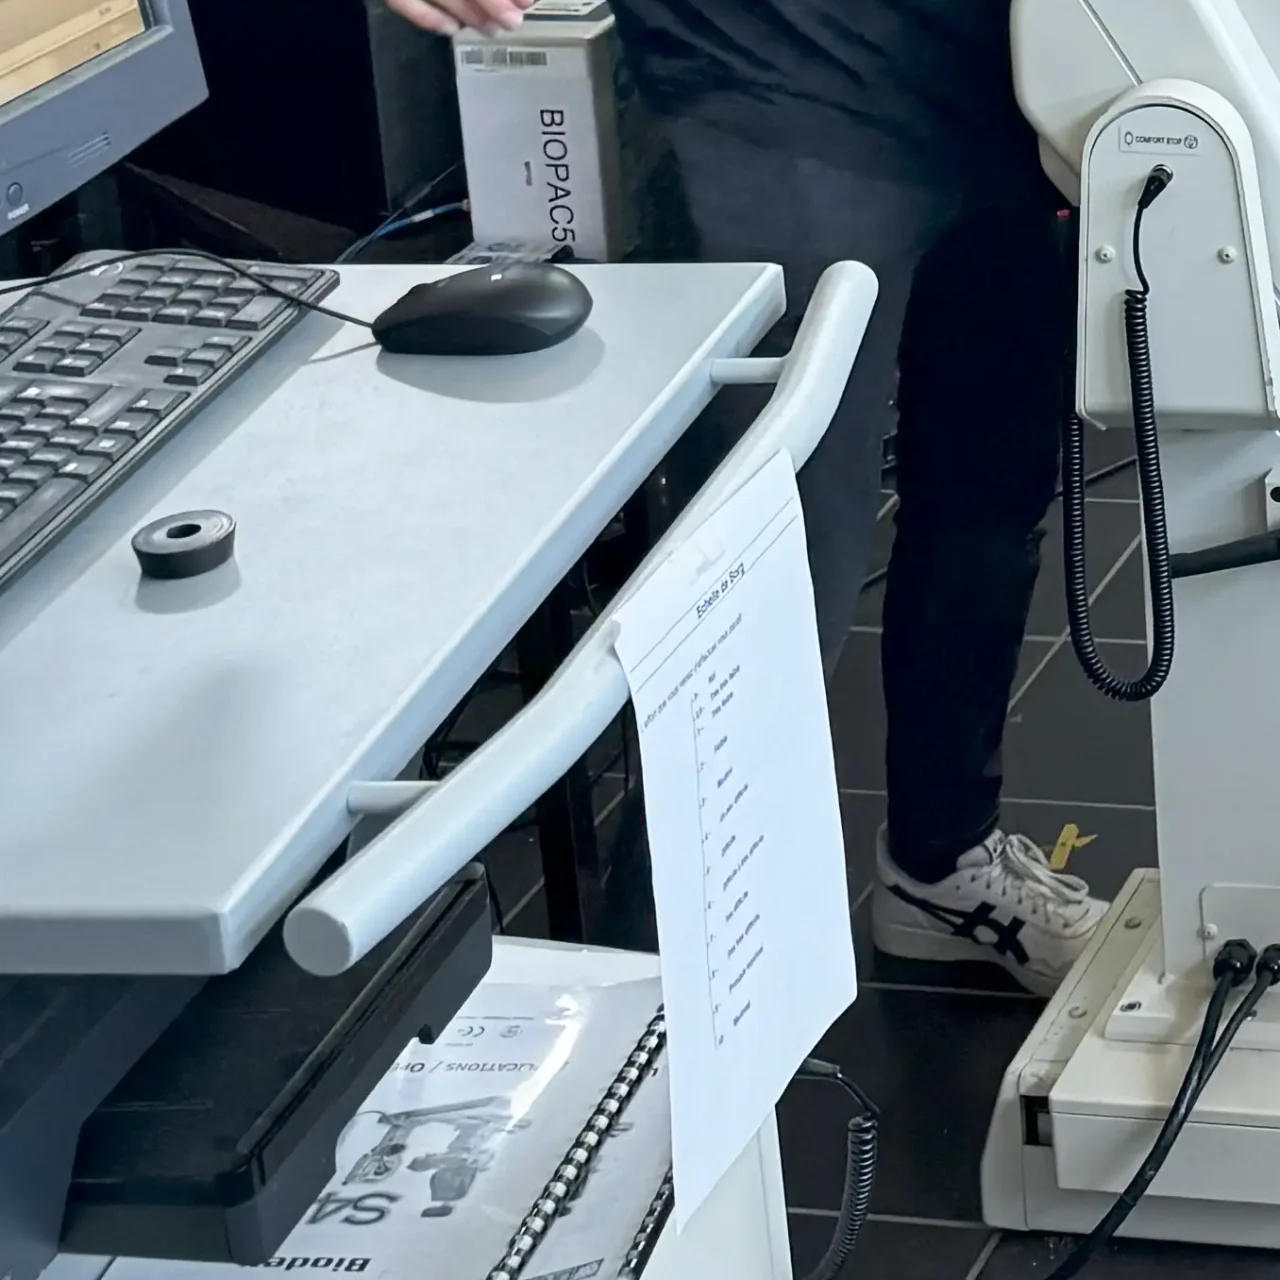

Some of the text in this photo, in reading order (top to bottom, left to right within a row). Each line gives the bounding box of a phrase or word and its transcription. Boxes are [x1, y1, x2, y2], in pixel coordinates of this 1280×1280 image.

[729, 562, 745, 584] Borg
[306, 1191, 403, 1226] S4
[265, 1257, 371, 1273] Biode
